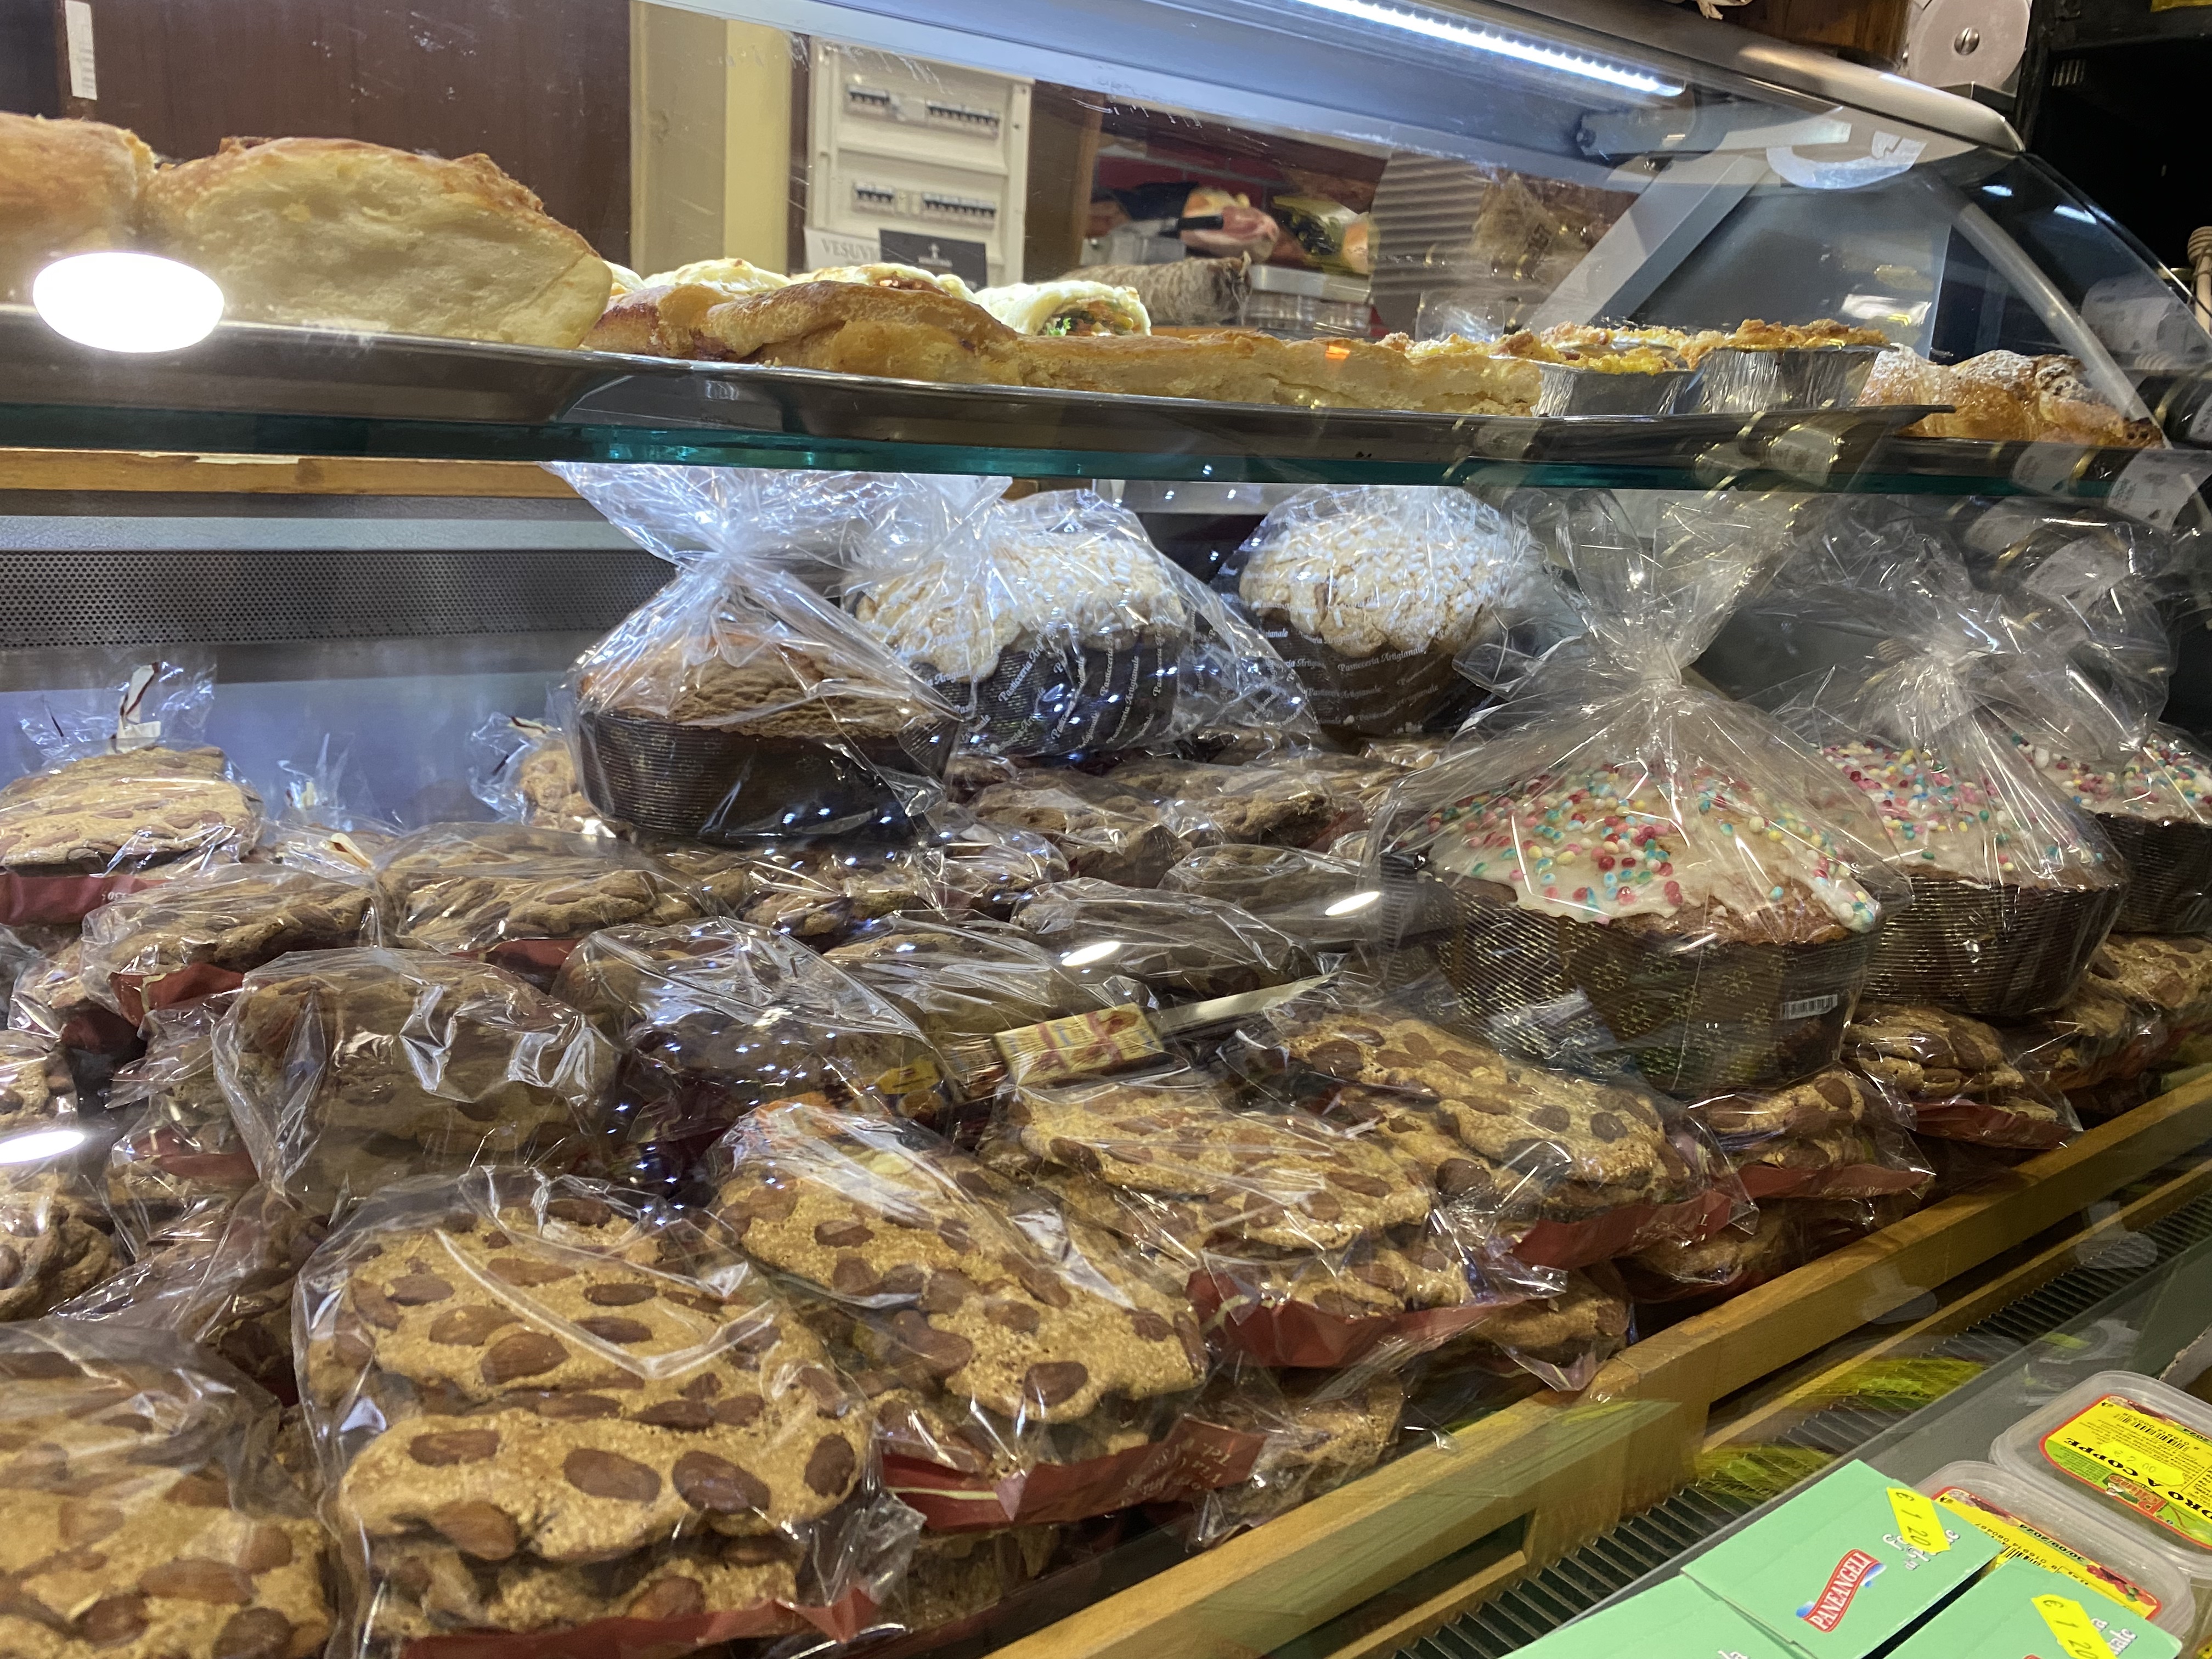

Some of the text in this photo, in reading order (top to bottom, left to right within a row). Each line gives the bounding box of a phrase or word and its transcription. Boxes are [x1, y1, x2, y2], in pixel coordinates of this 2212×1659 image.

[1338, 647, 1424, 673] Pasticceria Artigianale
[998, 661, 1033, 702] Pasticceria
[1126, 656, 1140, 705] Artigianale
[2183, 1428, 2210, 1443] 2024
[2063, 1437, 2138, 1476] COPPE
[2108, 1475, 2168, 1515] Pellino
[2146, 1477, 2164, 1487] A
[1895, 1491, 1931, 1547] € 1 20
[1809, 1551, 1873, 1630] PANEANGELI
[2042, 1599, 2064, 1608] €
